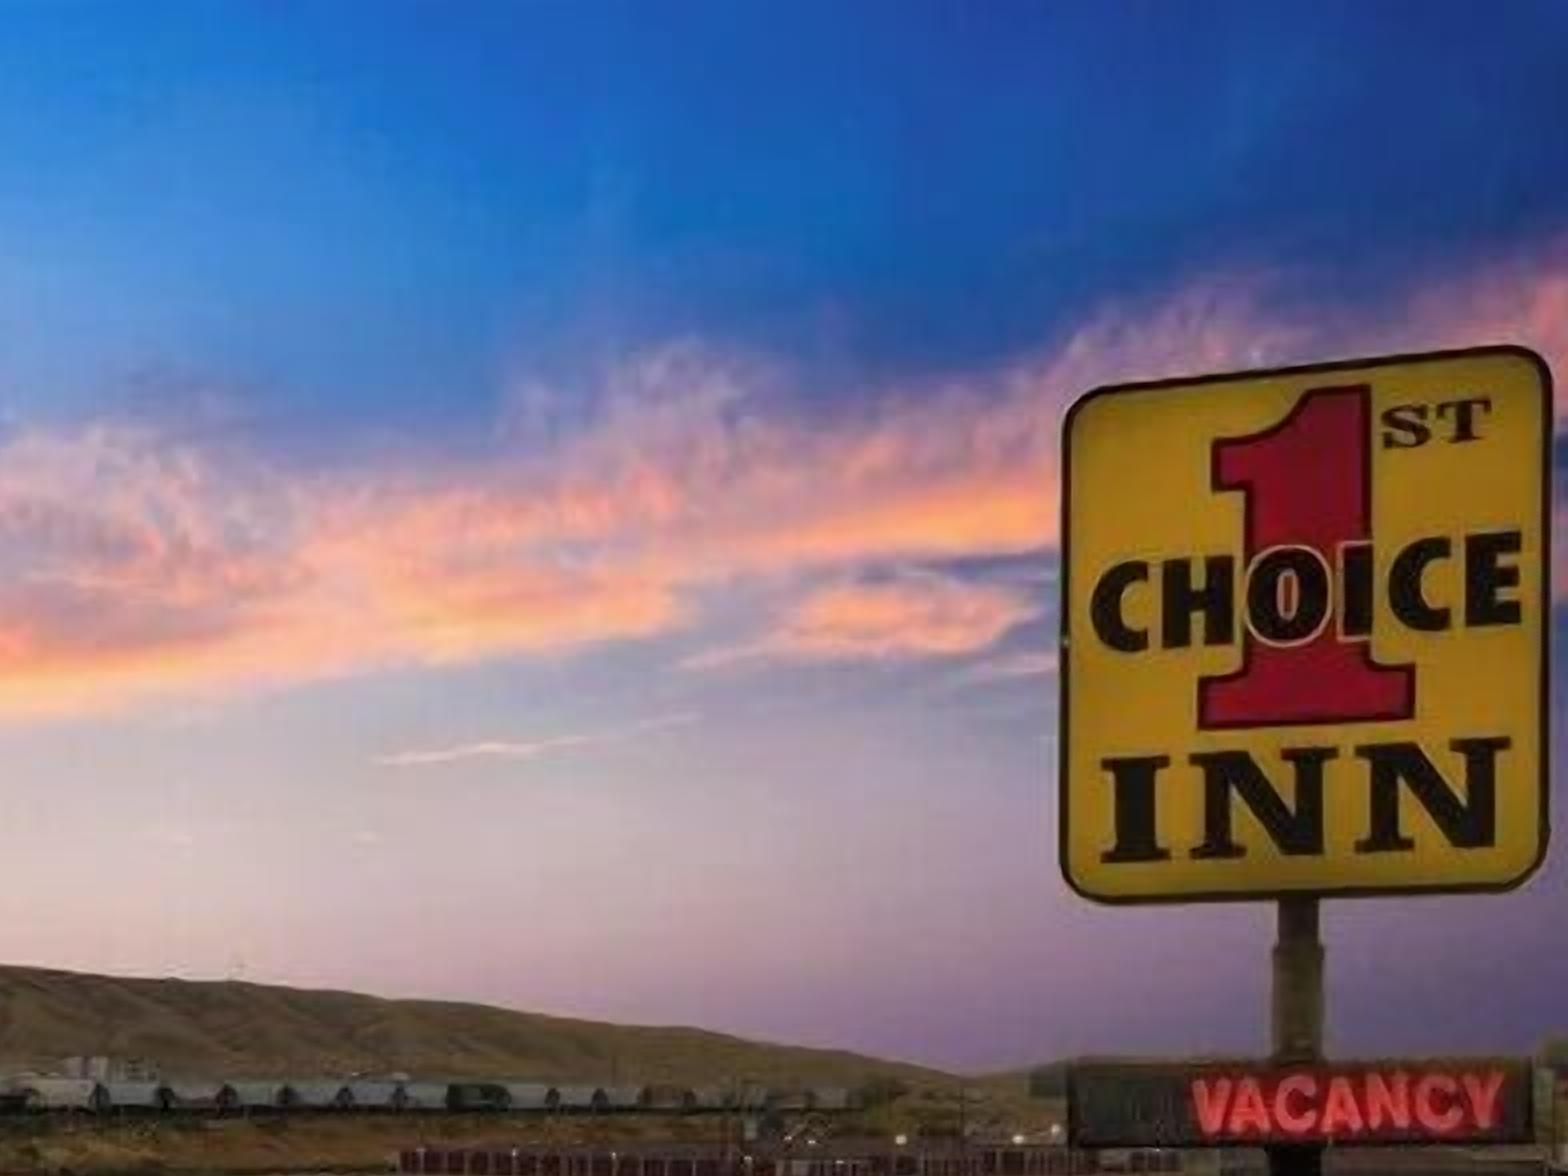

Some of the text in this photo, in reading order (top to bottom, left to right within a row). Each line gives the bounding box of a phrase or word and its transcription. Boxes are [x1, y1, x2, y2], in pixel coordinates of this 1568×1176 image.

[1089, 531, 1522, 653] CHOICE
[1100, 737, 1512, 864] INN
[1191, 1069, 1506, 1135] VACANCY
